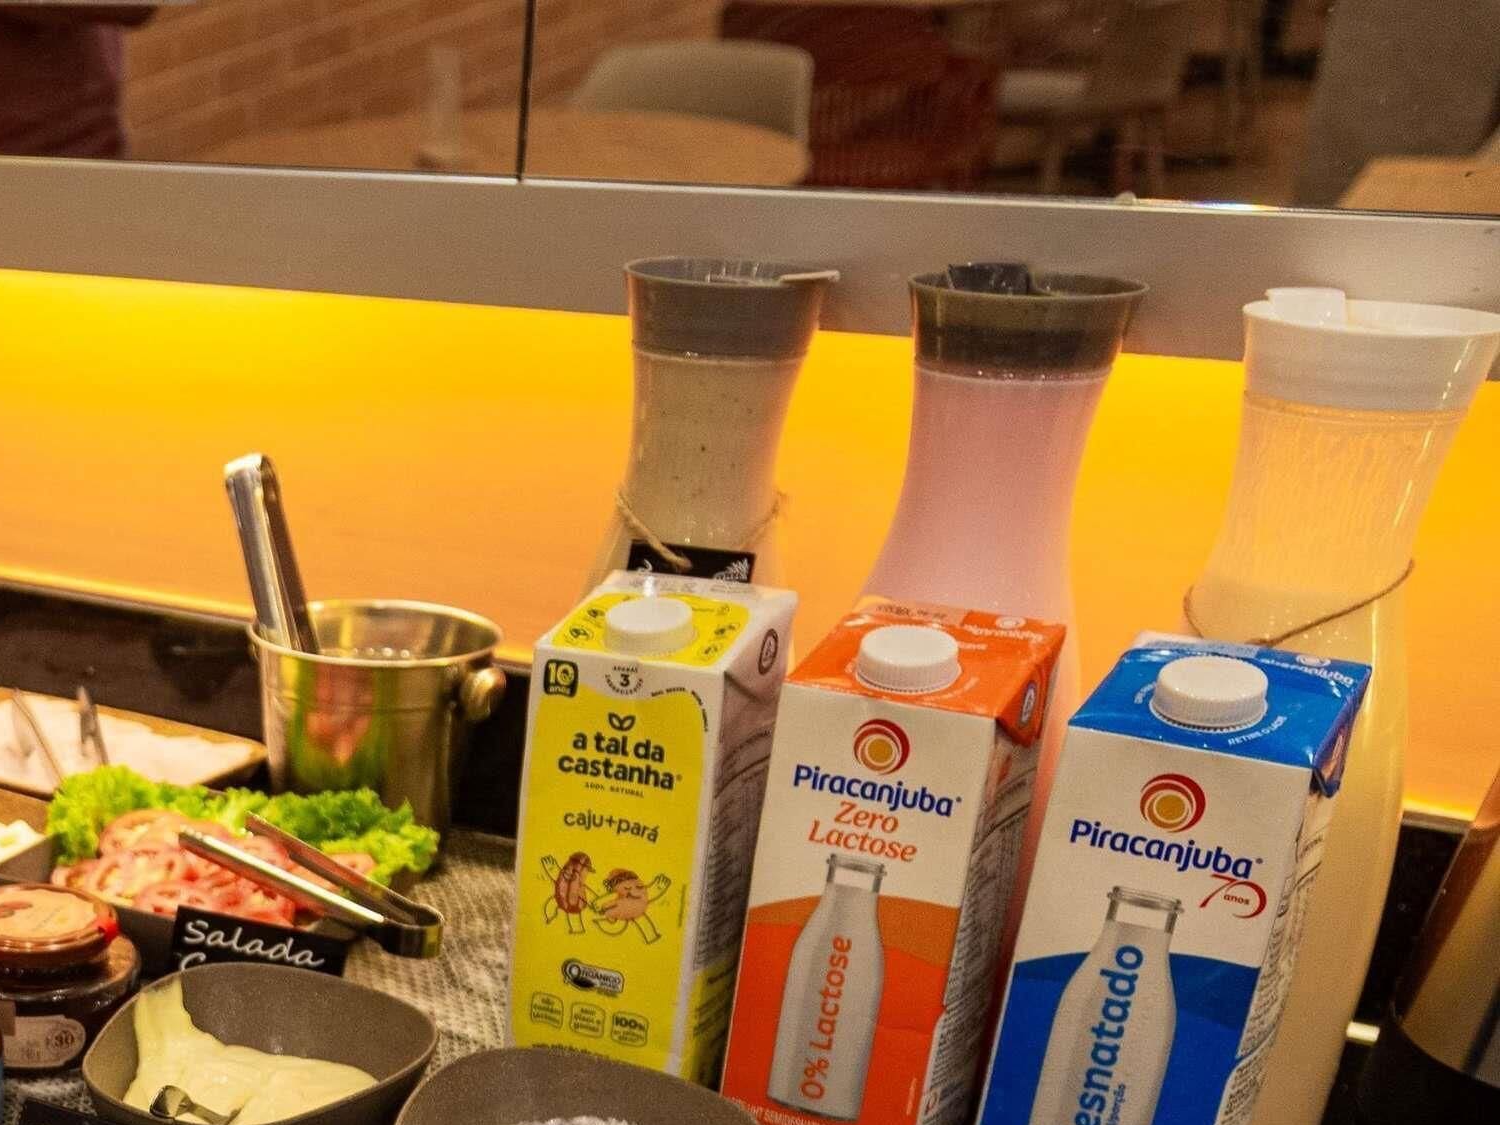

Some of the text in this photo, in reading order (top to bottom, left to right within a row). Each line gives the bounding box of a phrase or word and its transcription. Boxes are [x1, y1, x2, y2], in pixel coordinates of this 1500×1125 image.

[619, 673, 631, 688] 3
[572, 731, 665, 763] a tal da
[558, 755, 675, 792] castanha
[793, 764, 954, 817] Piracanjuba
[833, 800, 900, 834] Zero
[808, 820, 919, 863] Lactose
[1069, 818, 1254, 880] Piracanjuba
[1223, 893, 1250, 906] anos
[183, 919, 326, 968] Salada
[809, 934, 853, 1052] Lactose
